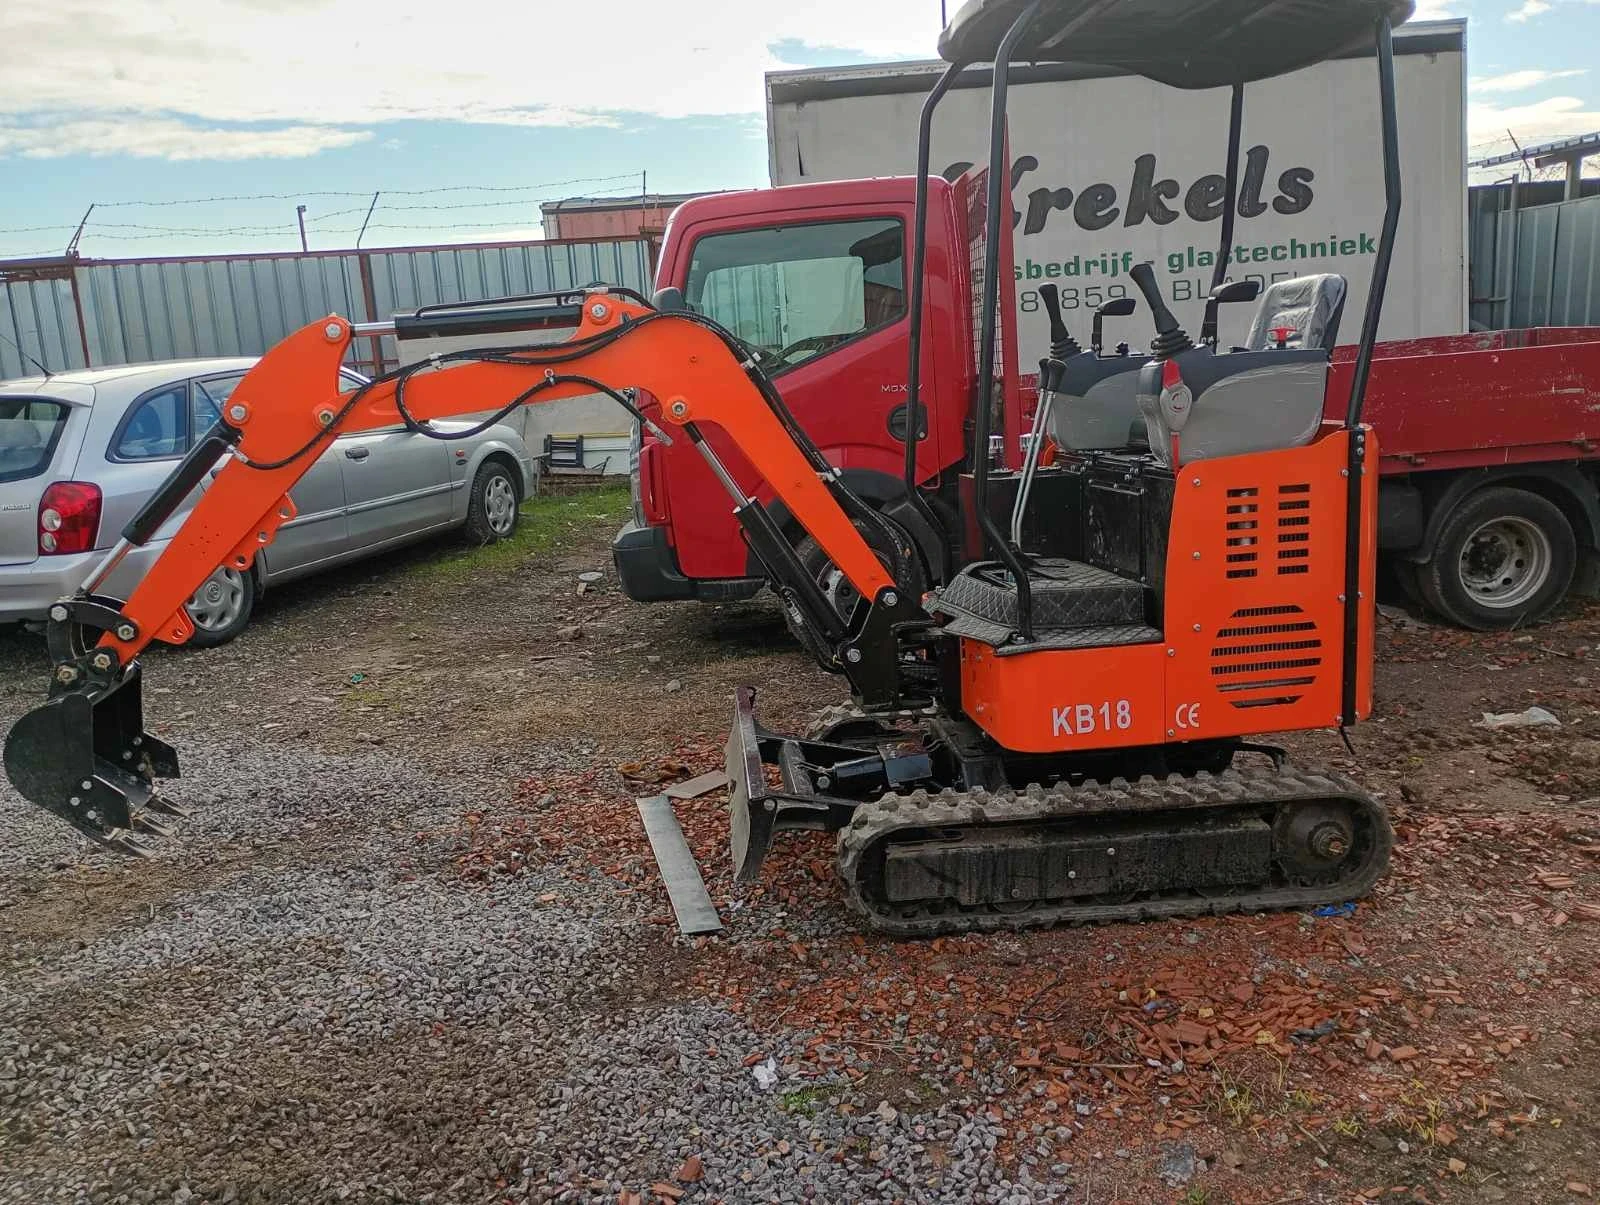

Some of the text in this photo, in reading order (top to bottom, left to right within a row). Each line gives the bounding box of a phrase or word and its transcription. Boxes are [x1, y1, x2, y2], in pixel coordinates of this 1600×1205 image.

[943, 145, 1317, 237] rekels
[1013, 251, 1134, 281] sbedrijf
[1166, 232, 1377, 274] glatechniek
[1051, 699, 1133, 738] KB18
[1174, 702, 1201, 729] CE
